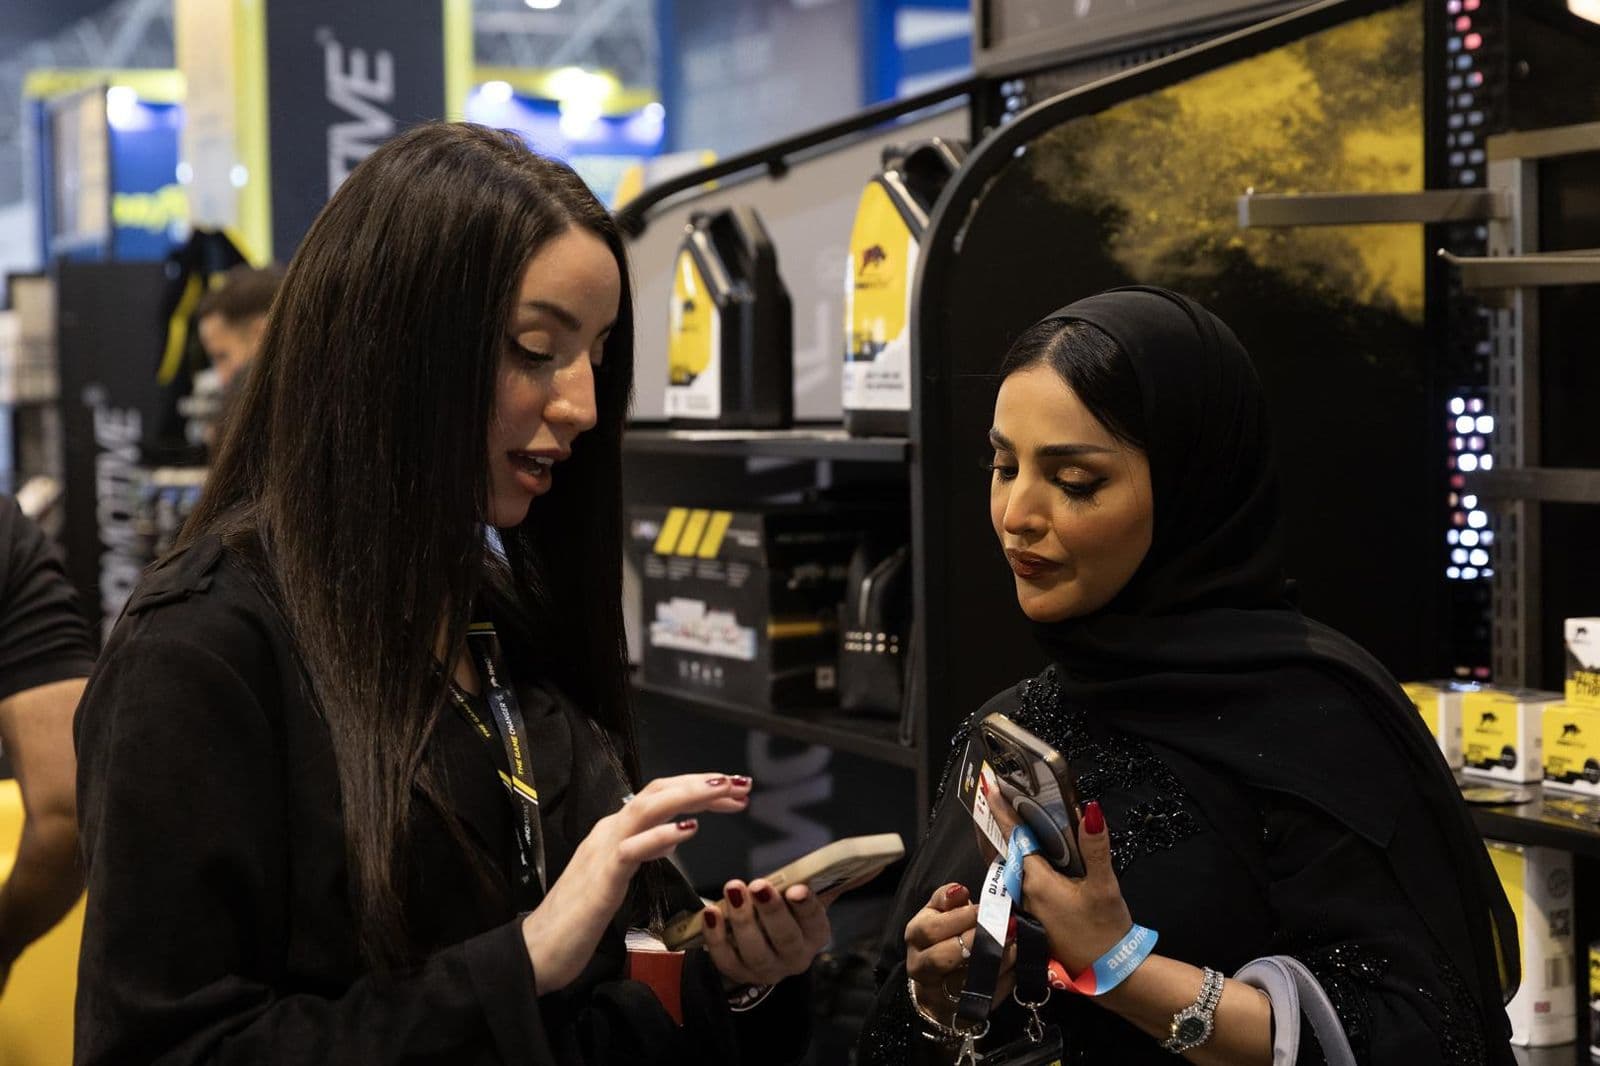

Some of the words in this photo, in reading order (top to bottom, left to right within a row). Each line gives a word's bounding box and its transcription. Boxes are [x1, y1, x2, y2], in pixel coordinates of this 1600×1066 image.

[499, 702, 516, 735] CHANGER
[510, 735, 521, 759] GAME
[515, 759, 524, 775] THE
